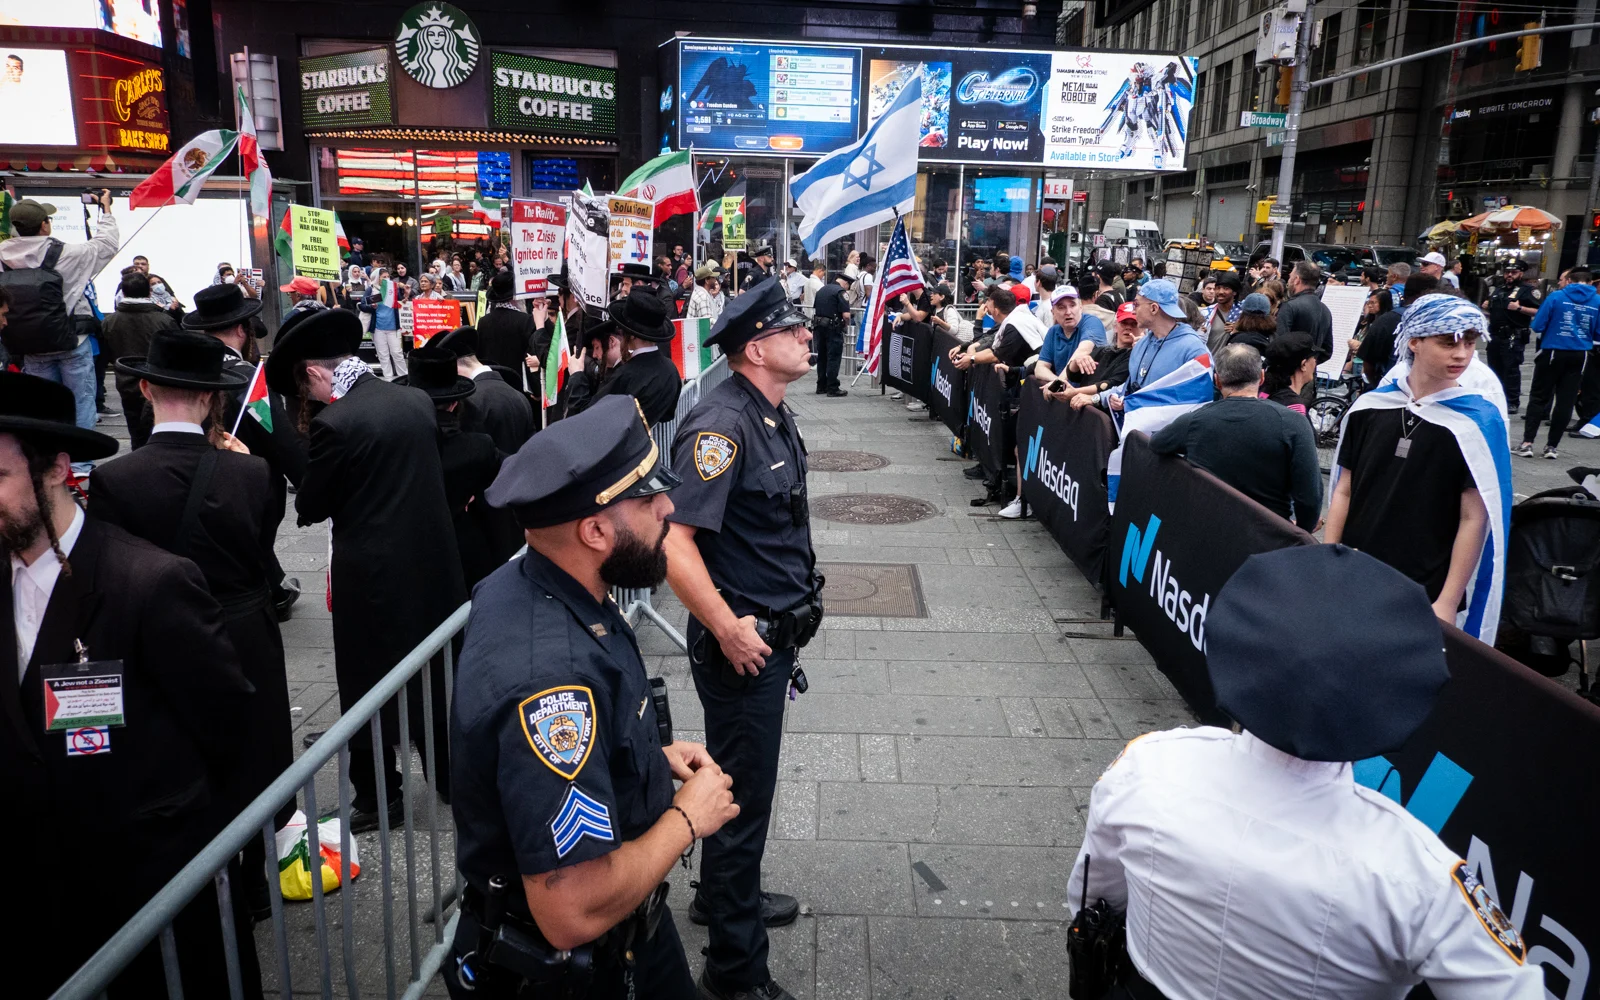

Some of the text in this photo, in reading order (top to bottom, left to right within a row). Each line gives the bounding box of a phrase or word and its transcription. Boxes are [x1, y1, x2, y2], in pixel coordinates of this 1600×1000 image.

[301, 62, 387, 91] STARBUCKS
[495, 67, 615, 101] STARBUCKS
[1061, 81, 1086, 92] METAL
[115, 69, 163, 122] CARLO'S
[316, 90, 371, 114] COFFEE
[517, 96, 593, 122] COFFEE
[1455, 109, 1471, 118] Nasdaq
[1478, 103, 1505, 115] REWRITE
[1251, 114, 1284, 128] Broadway
[1051, 125, 1101, 134] Strike Freedom
[120, 129, 168, 151] BAKE SHOP
[957, 136, 1029, 152] Play Now!
[1050, 135, 1077, 143] Gundam
[1050, 151, 1120, 162] Available in Store
[523, 205, 535, 218] The
[312, 218, 329, 227] ISRAELI
[309, 236, 322, 244] FREE
[521, 229, 535, 242] The
[616, 229, 624, 237] the
[301, 244, 329, 254] PALESTINE!
[514, 246, 544, 264] Ignited
[545, 247, 558, 260] Fire
[611, 250, 622, 260] State
[302, 254, 329, 266] STOP ICE!
[519, 267, 529, 276] Both
[529, 266, 541, 275] Now
[934, 367, 952, 407] Nasdaq
[700, 439, 733, 455] DEPARTMENT
[708, 435, 729, 447] POLICE
[1036, 446, 1080, 522] Nasdaq
[1149, 549, 1210, 656] Nasd
[94, 677, 119, 686] Zionist
[539, 691, 576, 709] POLICE
[529, 700, 589, 725] DEPARTMENT
[572, 717, 592, 765] NEW YORK
[532, 733, 562, 765] CITY OF
